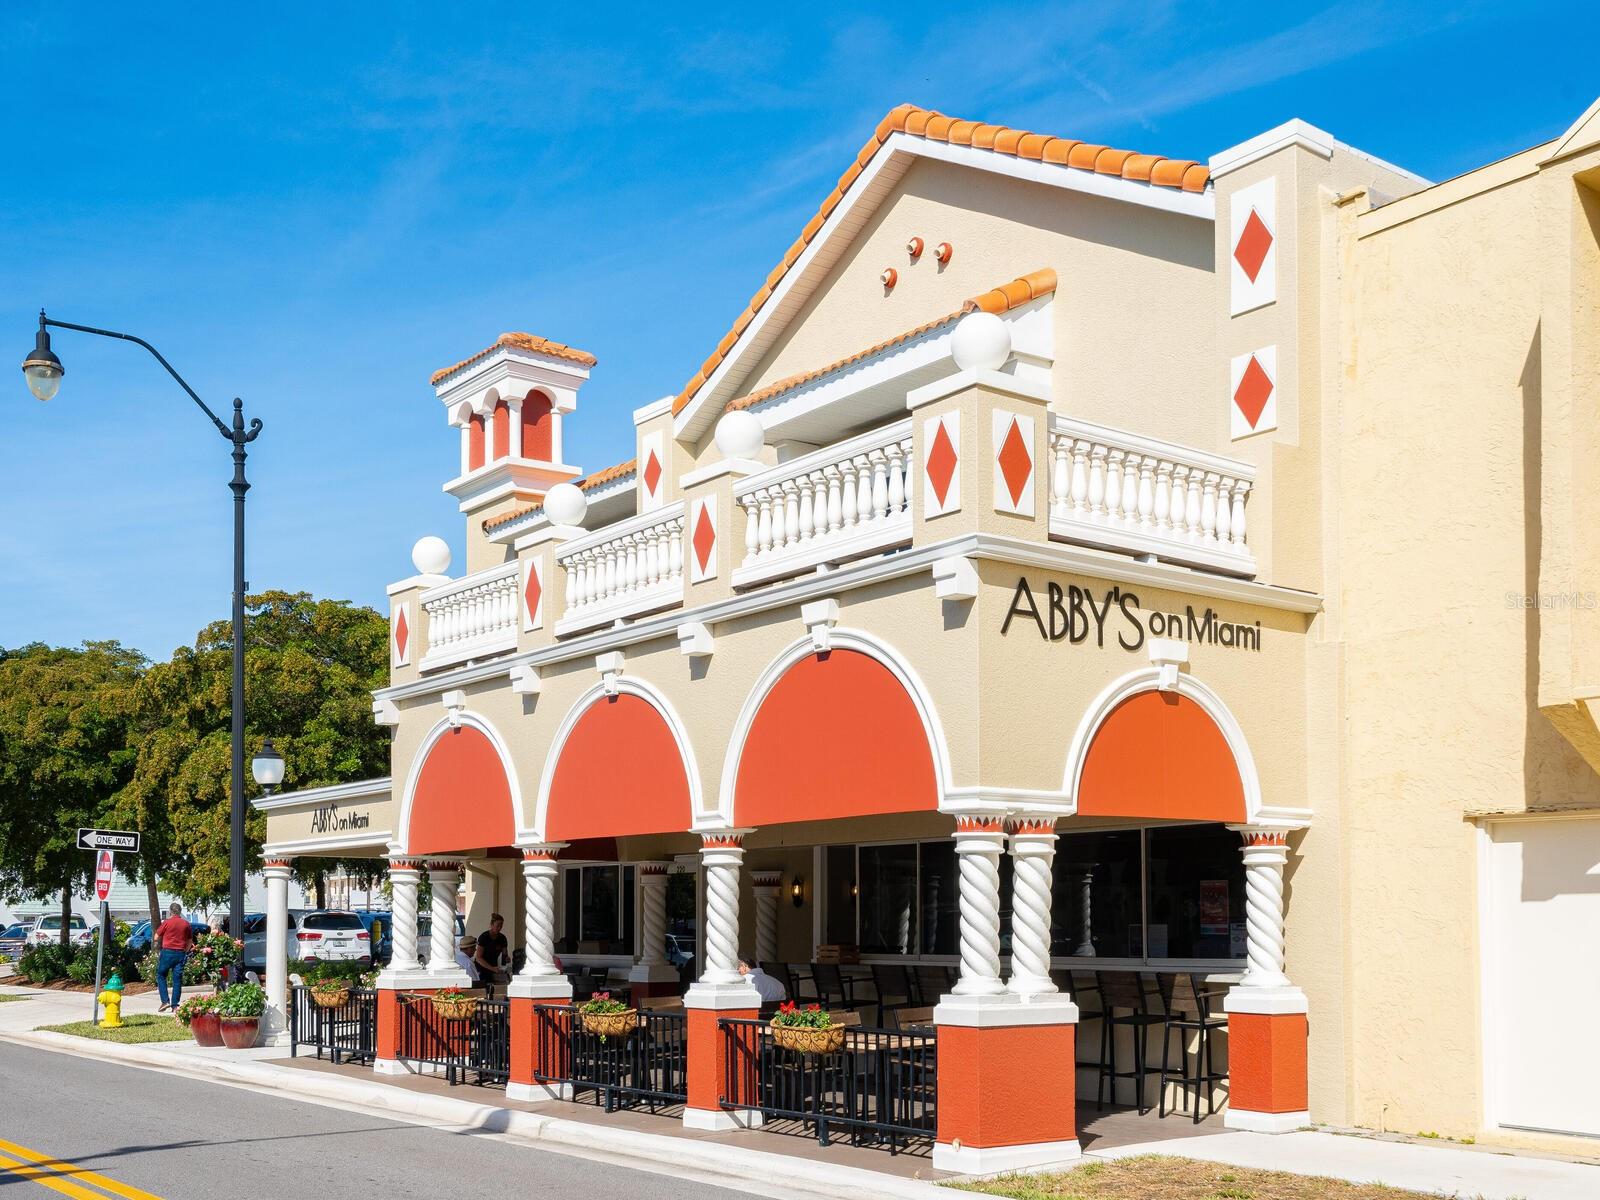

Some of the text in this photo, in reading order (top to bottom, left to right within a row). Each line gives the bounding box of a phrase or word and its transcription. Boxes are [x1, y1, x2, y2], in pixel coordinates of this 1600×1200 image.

[1000, 577, 1261, 651] ABBY'S on Miami
[311, 803, 370, 833] ABBY'S on Miami
[96, 836, 132, 846] ONE WAY
